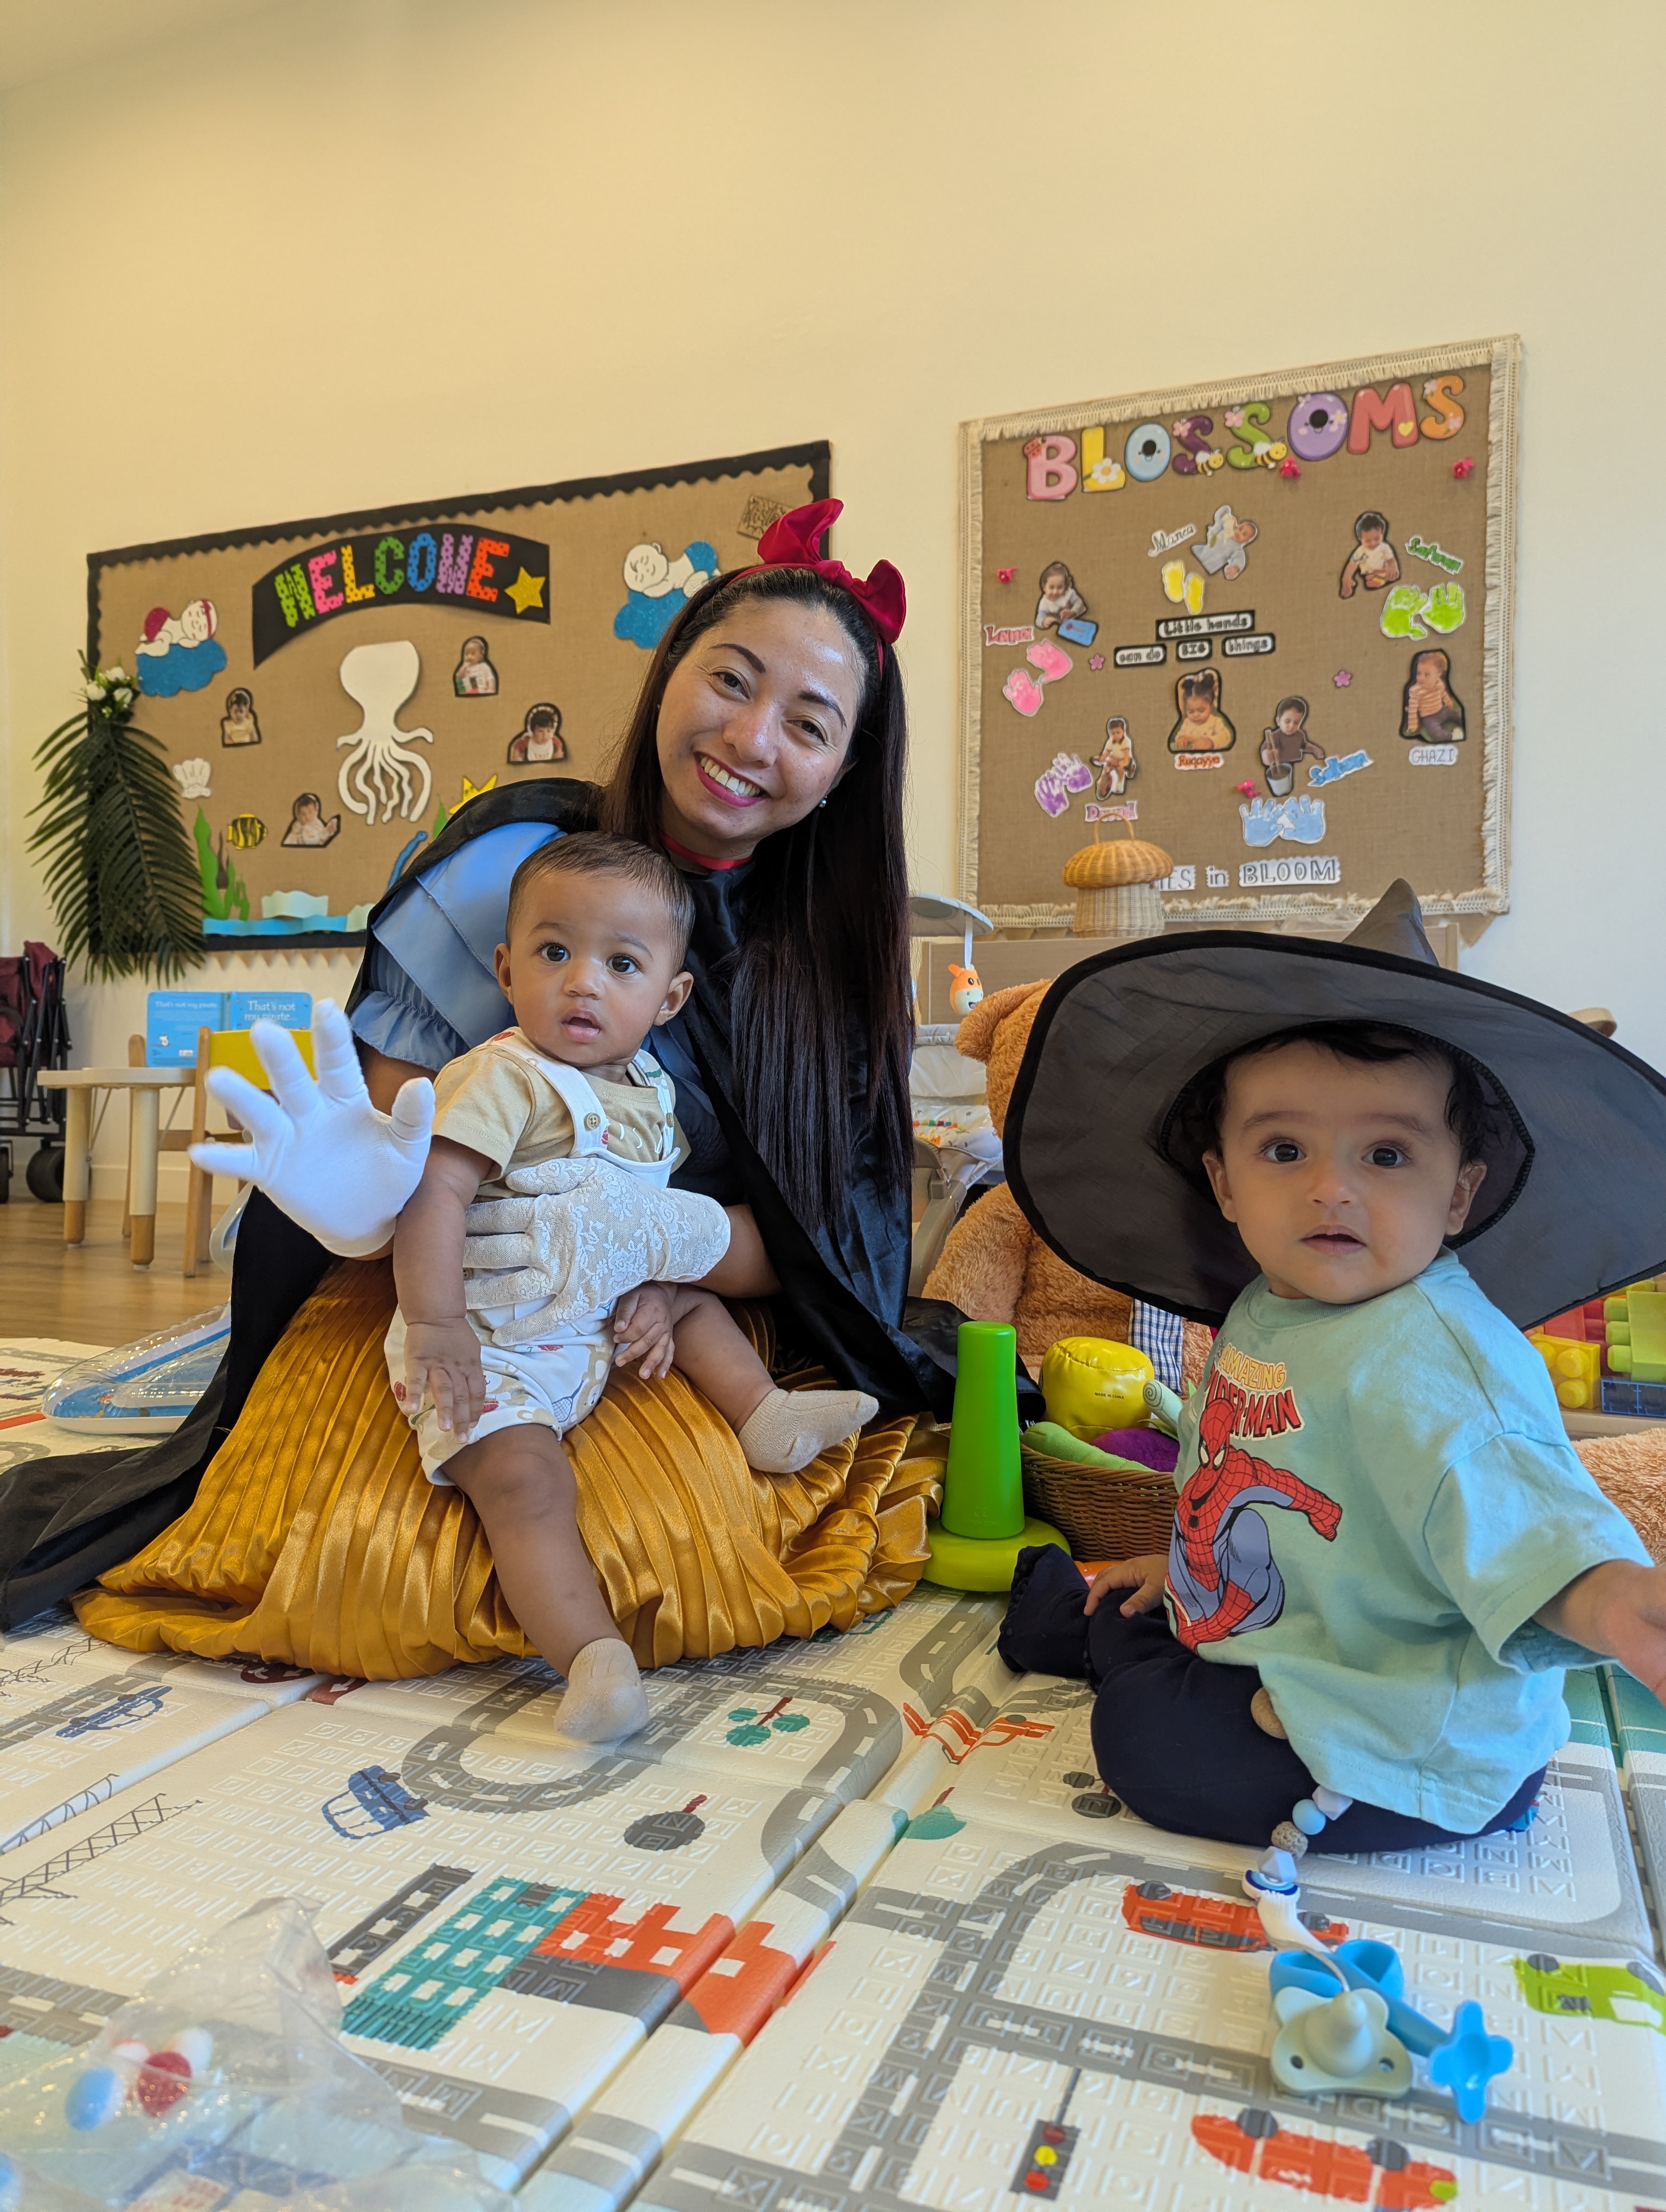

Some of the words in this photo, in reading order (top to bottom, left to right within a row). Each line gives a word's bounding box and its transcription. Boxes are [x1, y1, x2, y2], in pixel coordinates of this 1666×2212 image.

[1022, 375, 1465, 501] BLOSSOMS
[274, 532, 510, 628] WELCOME
[1163, 620, 1202, 636] Little
[1207, 613, 1248, 630] hands
[1119, 652, 1142, 663] can
[1145, 648, 1161, 661] do
[1181, 642, 1206, 657] BIG
[1228, 637, 1268, 653] things
[1411, 748, 1454, 763] GHAZI
[1209, 866, 1226, 885] in
[1242, 859, 1336, 885] BLOOM
[248, 1000, 277, 1011] That's
[279, 1002, 296, 1011] not
[1219, 1343, 1286, 1391] AMAZING
